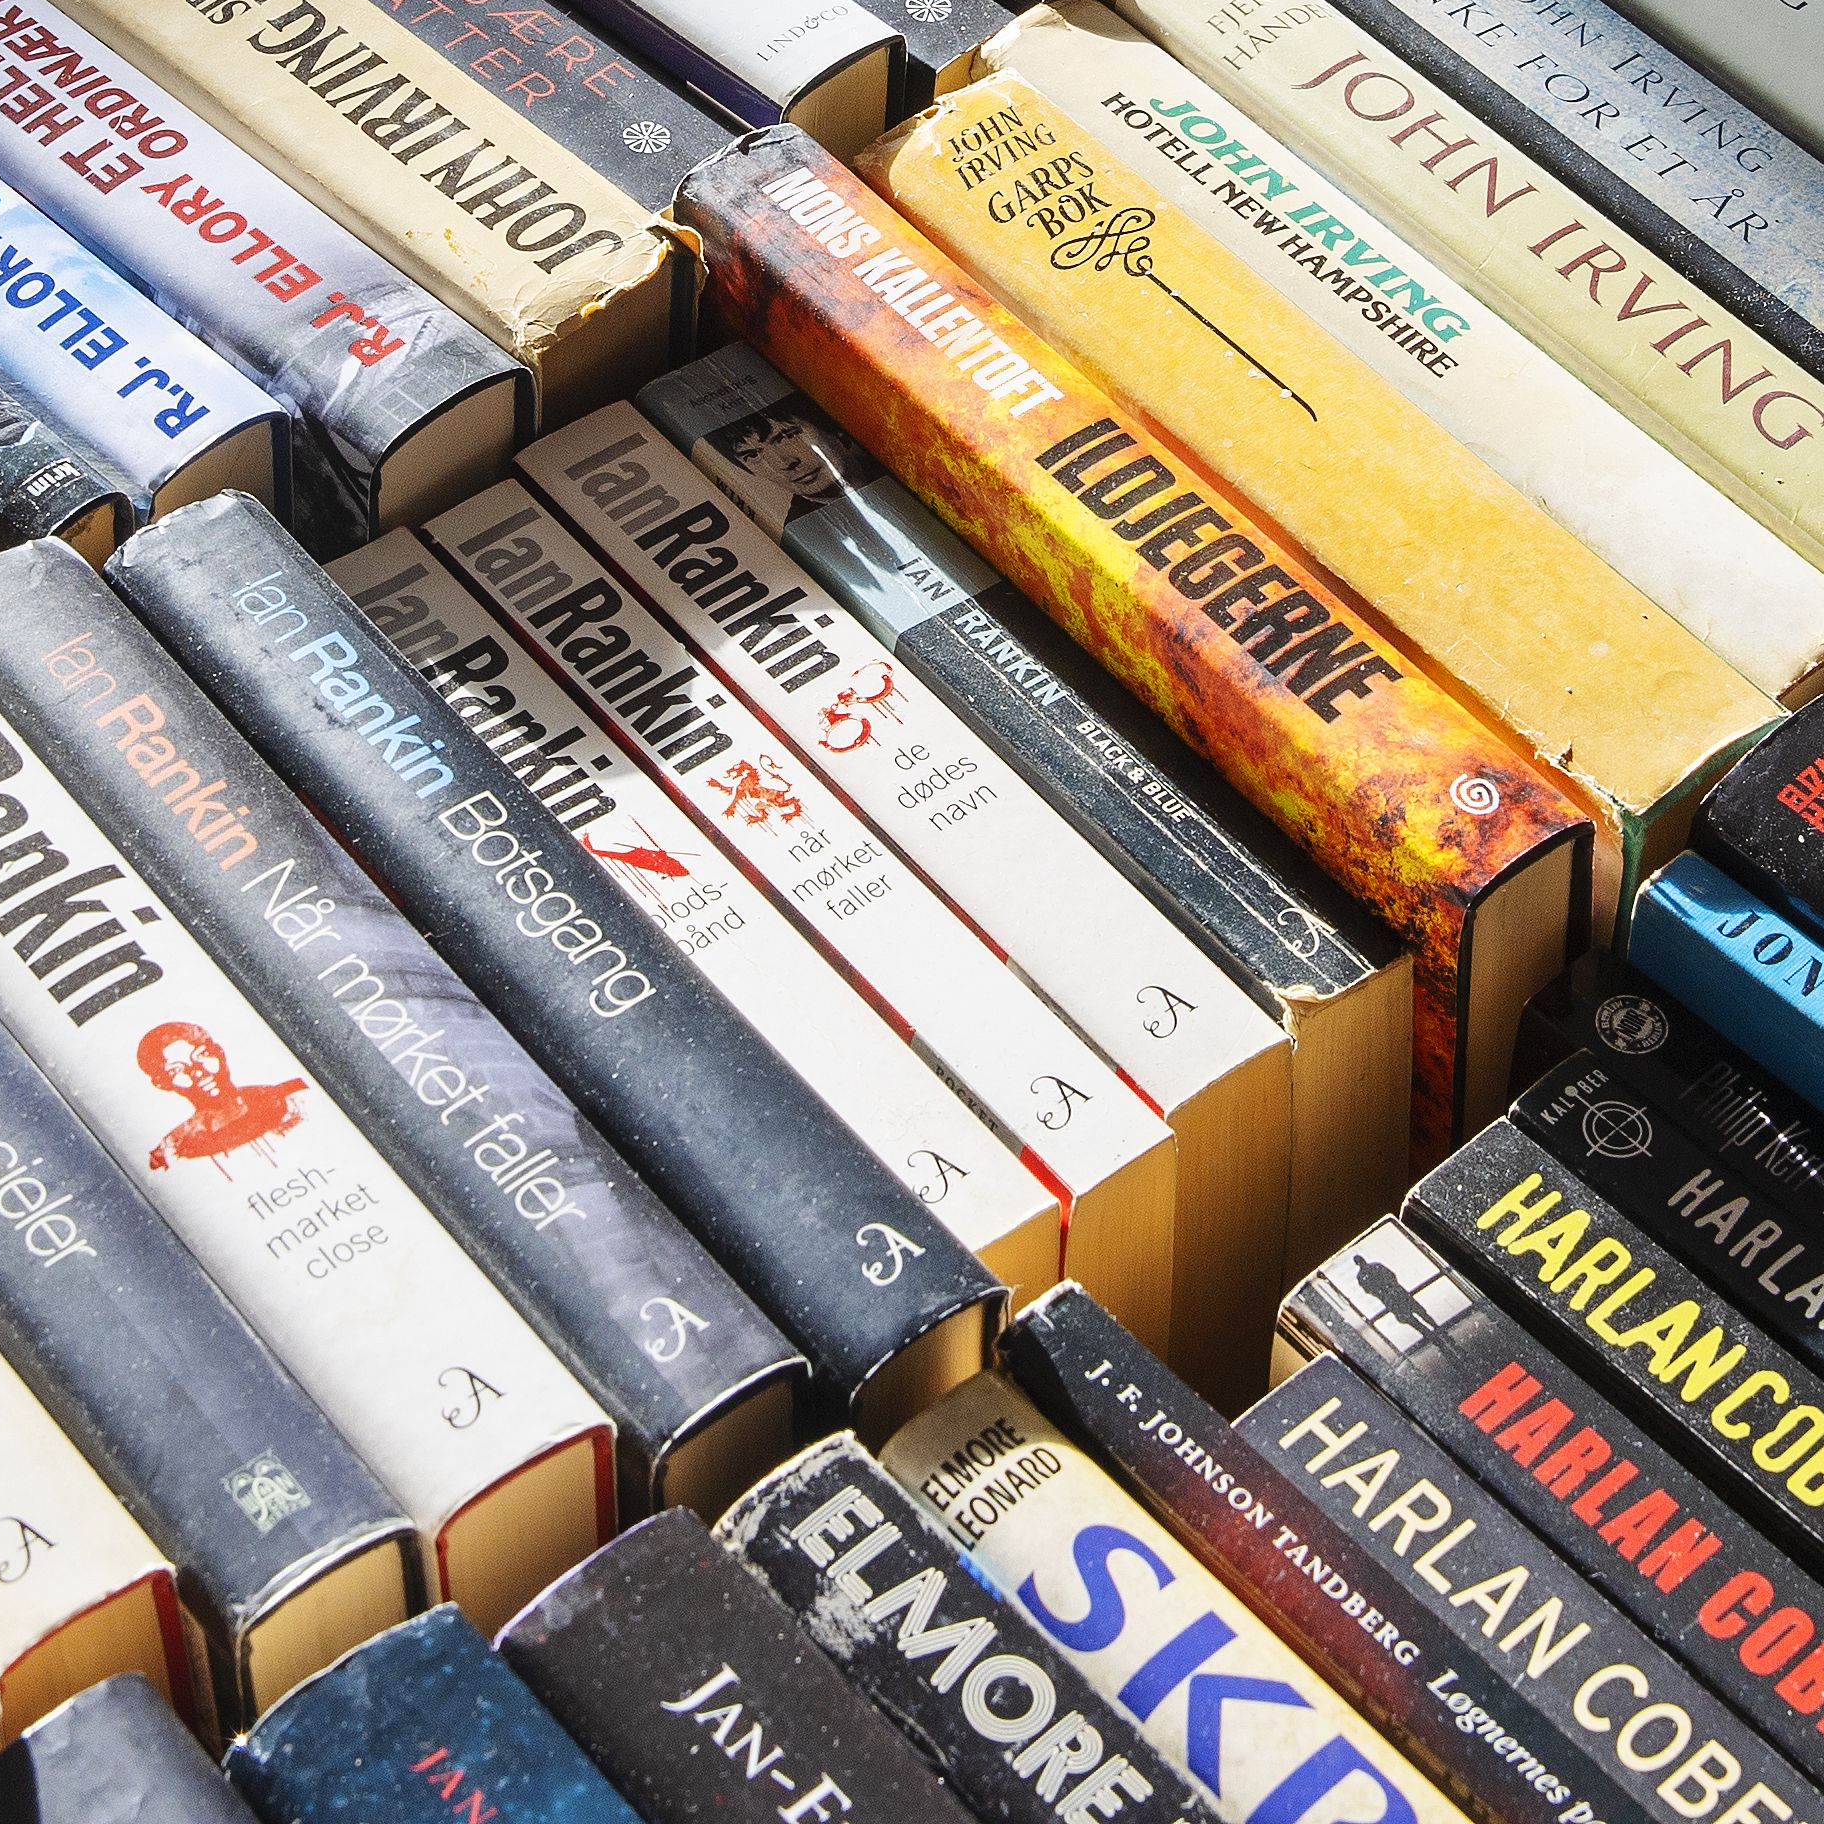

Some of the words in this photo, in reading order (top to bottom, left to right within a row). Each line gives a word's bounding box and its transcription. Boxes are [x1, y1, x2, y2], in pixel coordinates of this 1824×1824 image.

[987, 150, 1096, 229] GARPS
[1026, 180, 1105, 238] BOK
[1289, 48, 1533, 221] JOHN
[762, 167, 876, 263] MONS
[853, 247, 1064, 420] KALLENTOFT
[1035, 418, 1404, 723] ILDJEGERNE
[230, 571, 314, 645] Ian
[303, 629, 455, 799] Rankin
[439, 789, 657, 1020] Botsgang
[42, 631, 121, 714] Ian
[97, 692, 261, 871] Rankin
[241, 859, 342, 954] Når
[317, 949, 488, 1126] mørket
[465, 1111, 587, 1232] faller
[922, 1416, 1026, 1520] ELMORE
[945, 1444, 1064, 1554] LEONARD
[1137, 1413, 1272, 1530] JOHNSON
[1270, 1525, 1421, 1667] TANDBERG
[1457, 1361, 1724, 1591] HARLAN
[1426, 1667, 1571, 1803] Løgnernes
